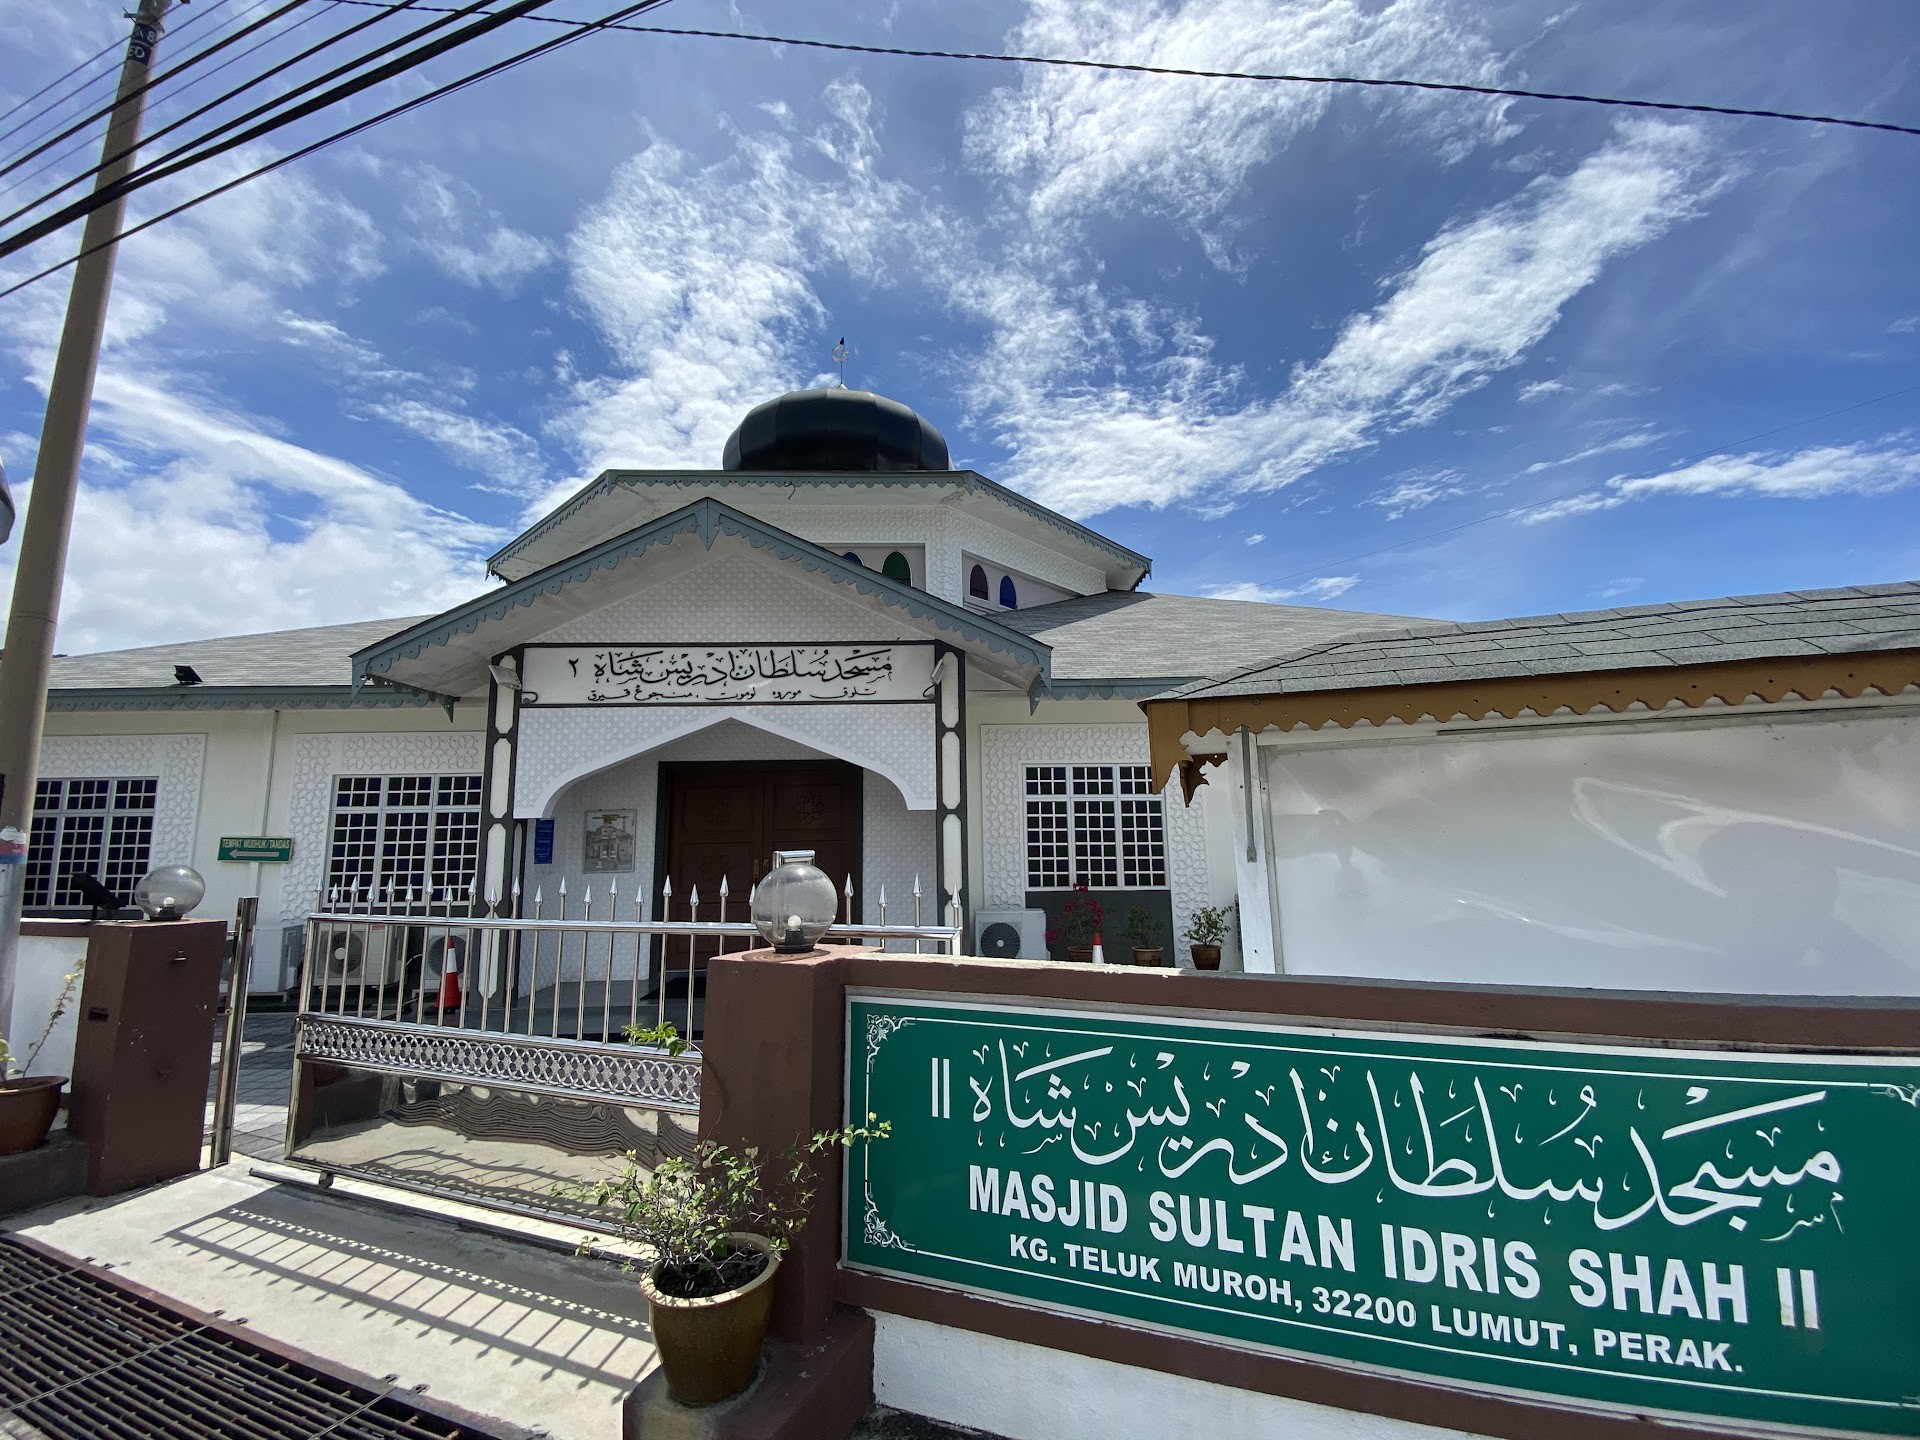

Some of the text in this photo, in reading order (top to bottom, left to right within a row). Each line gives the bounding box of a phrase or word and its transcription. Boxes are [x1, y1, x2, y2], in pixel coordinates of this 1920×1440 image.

[969, 1164, 1820, 1330] MASJID SULTAN IDRIS SHAH II
[1009, 1234, 1744, 1372] KG. TELUK MUROH, 32200 LUMUT, PERAK.
